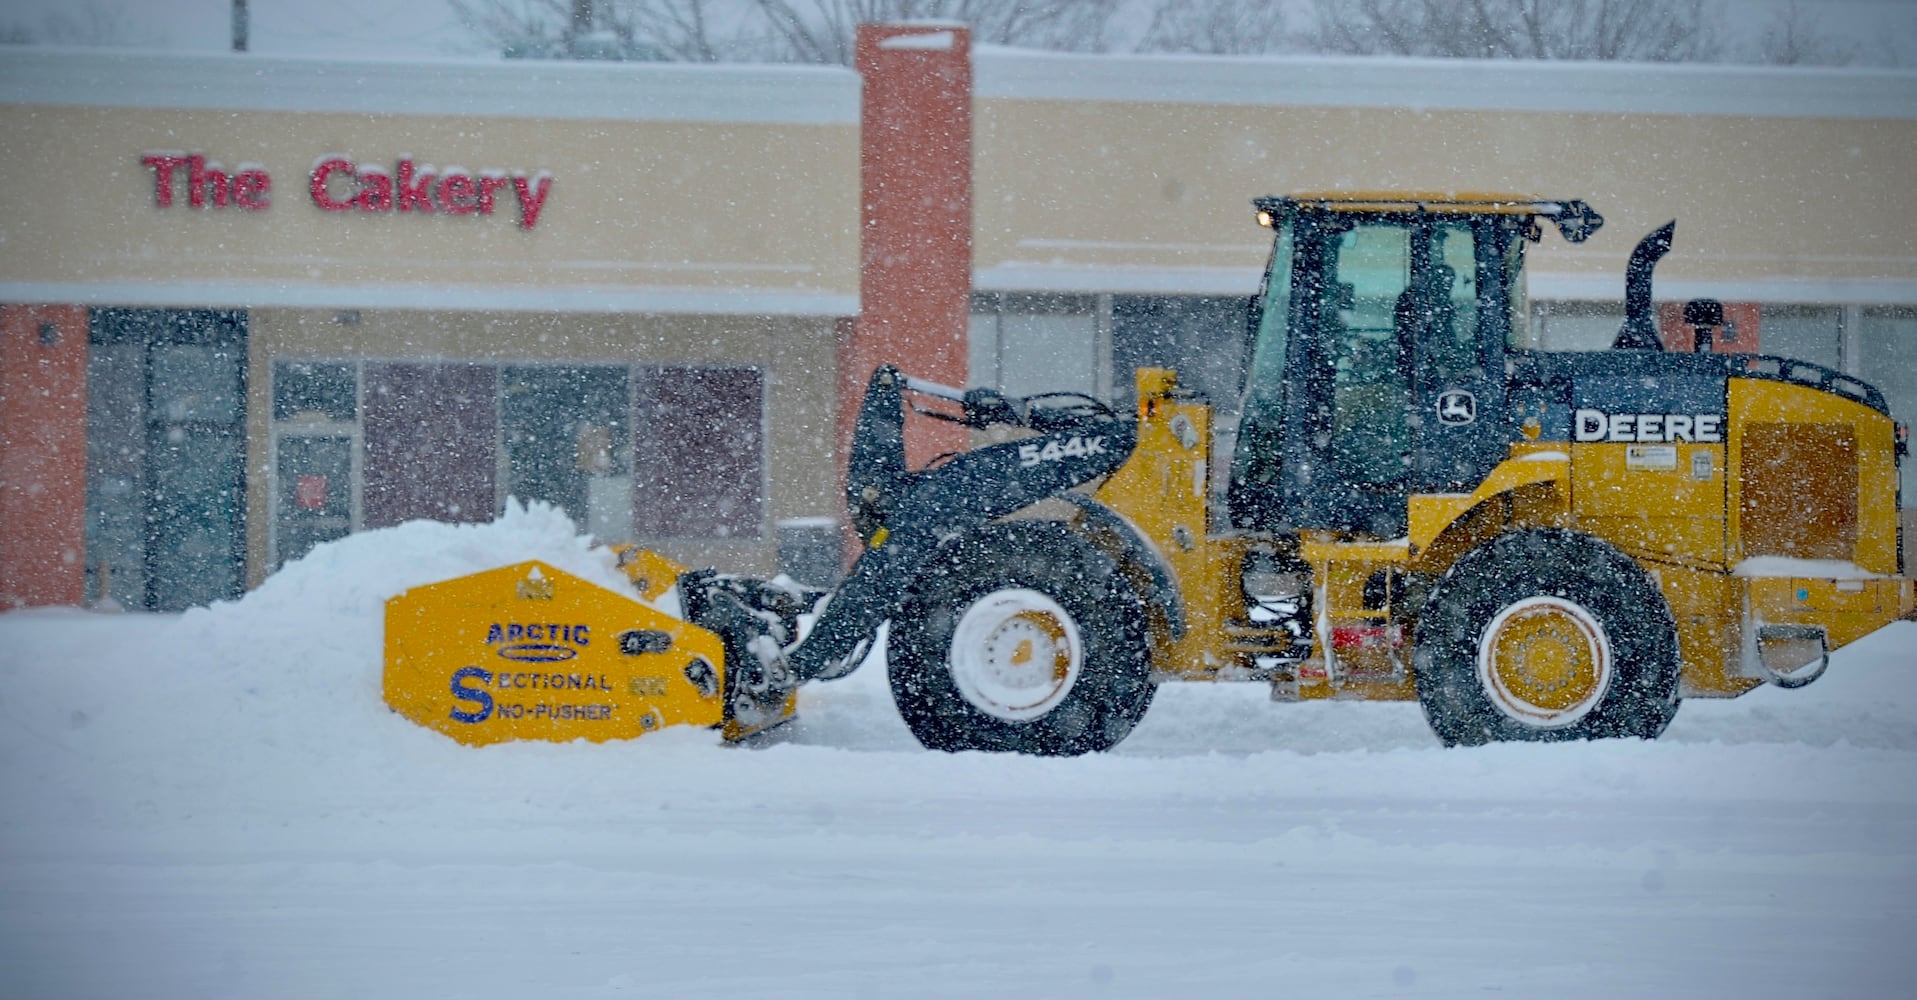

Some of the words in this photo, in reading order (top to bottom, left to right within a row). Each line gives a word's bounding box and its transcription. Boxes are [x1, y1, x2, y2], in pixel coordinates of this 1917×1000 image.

[141, 152, 270, 209] The
[310, 156, 552, 229] Cakery
[1575, 409, 1720, 442] DEERE
[1019, 435, 1108, 467] 544K
[488, 623, 590, 645] ARCTIC
